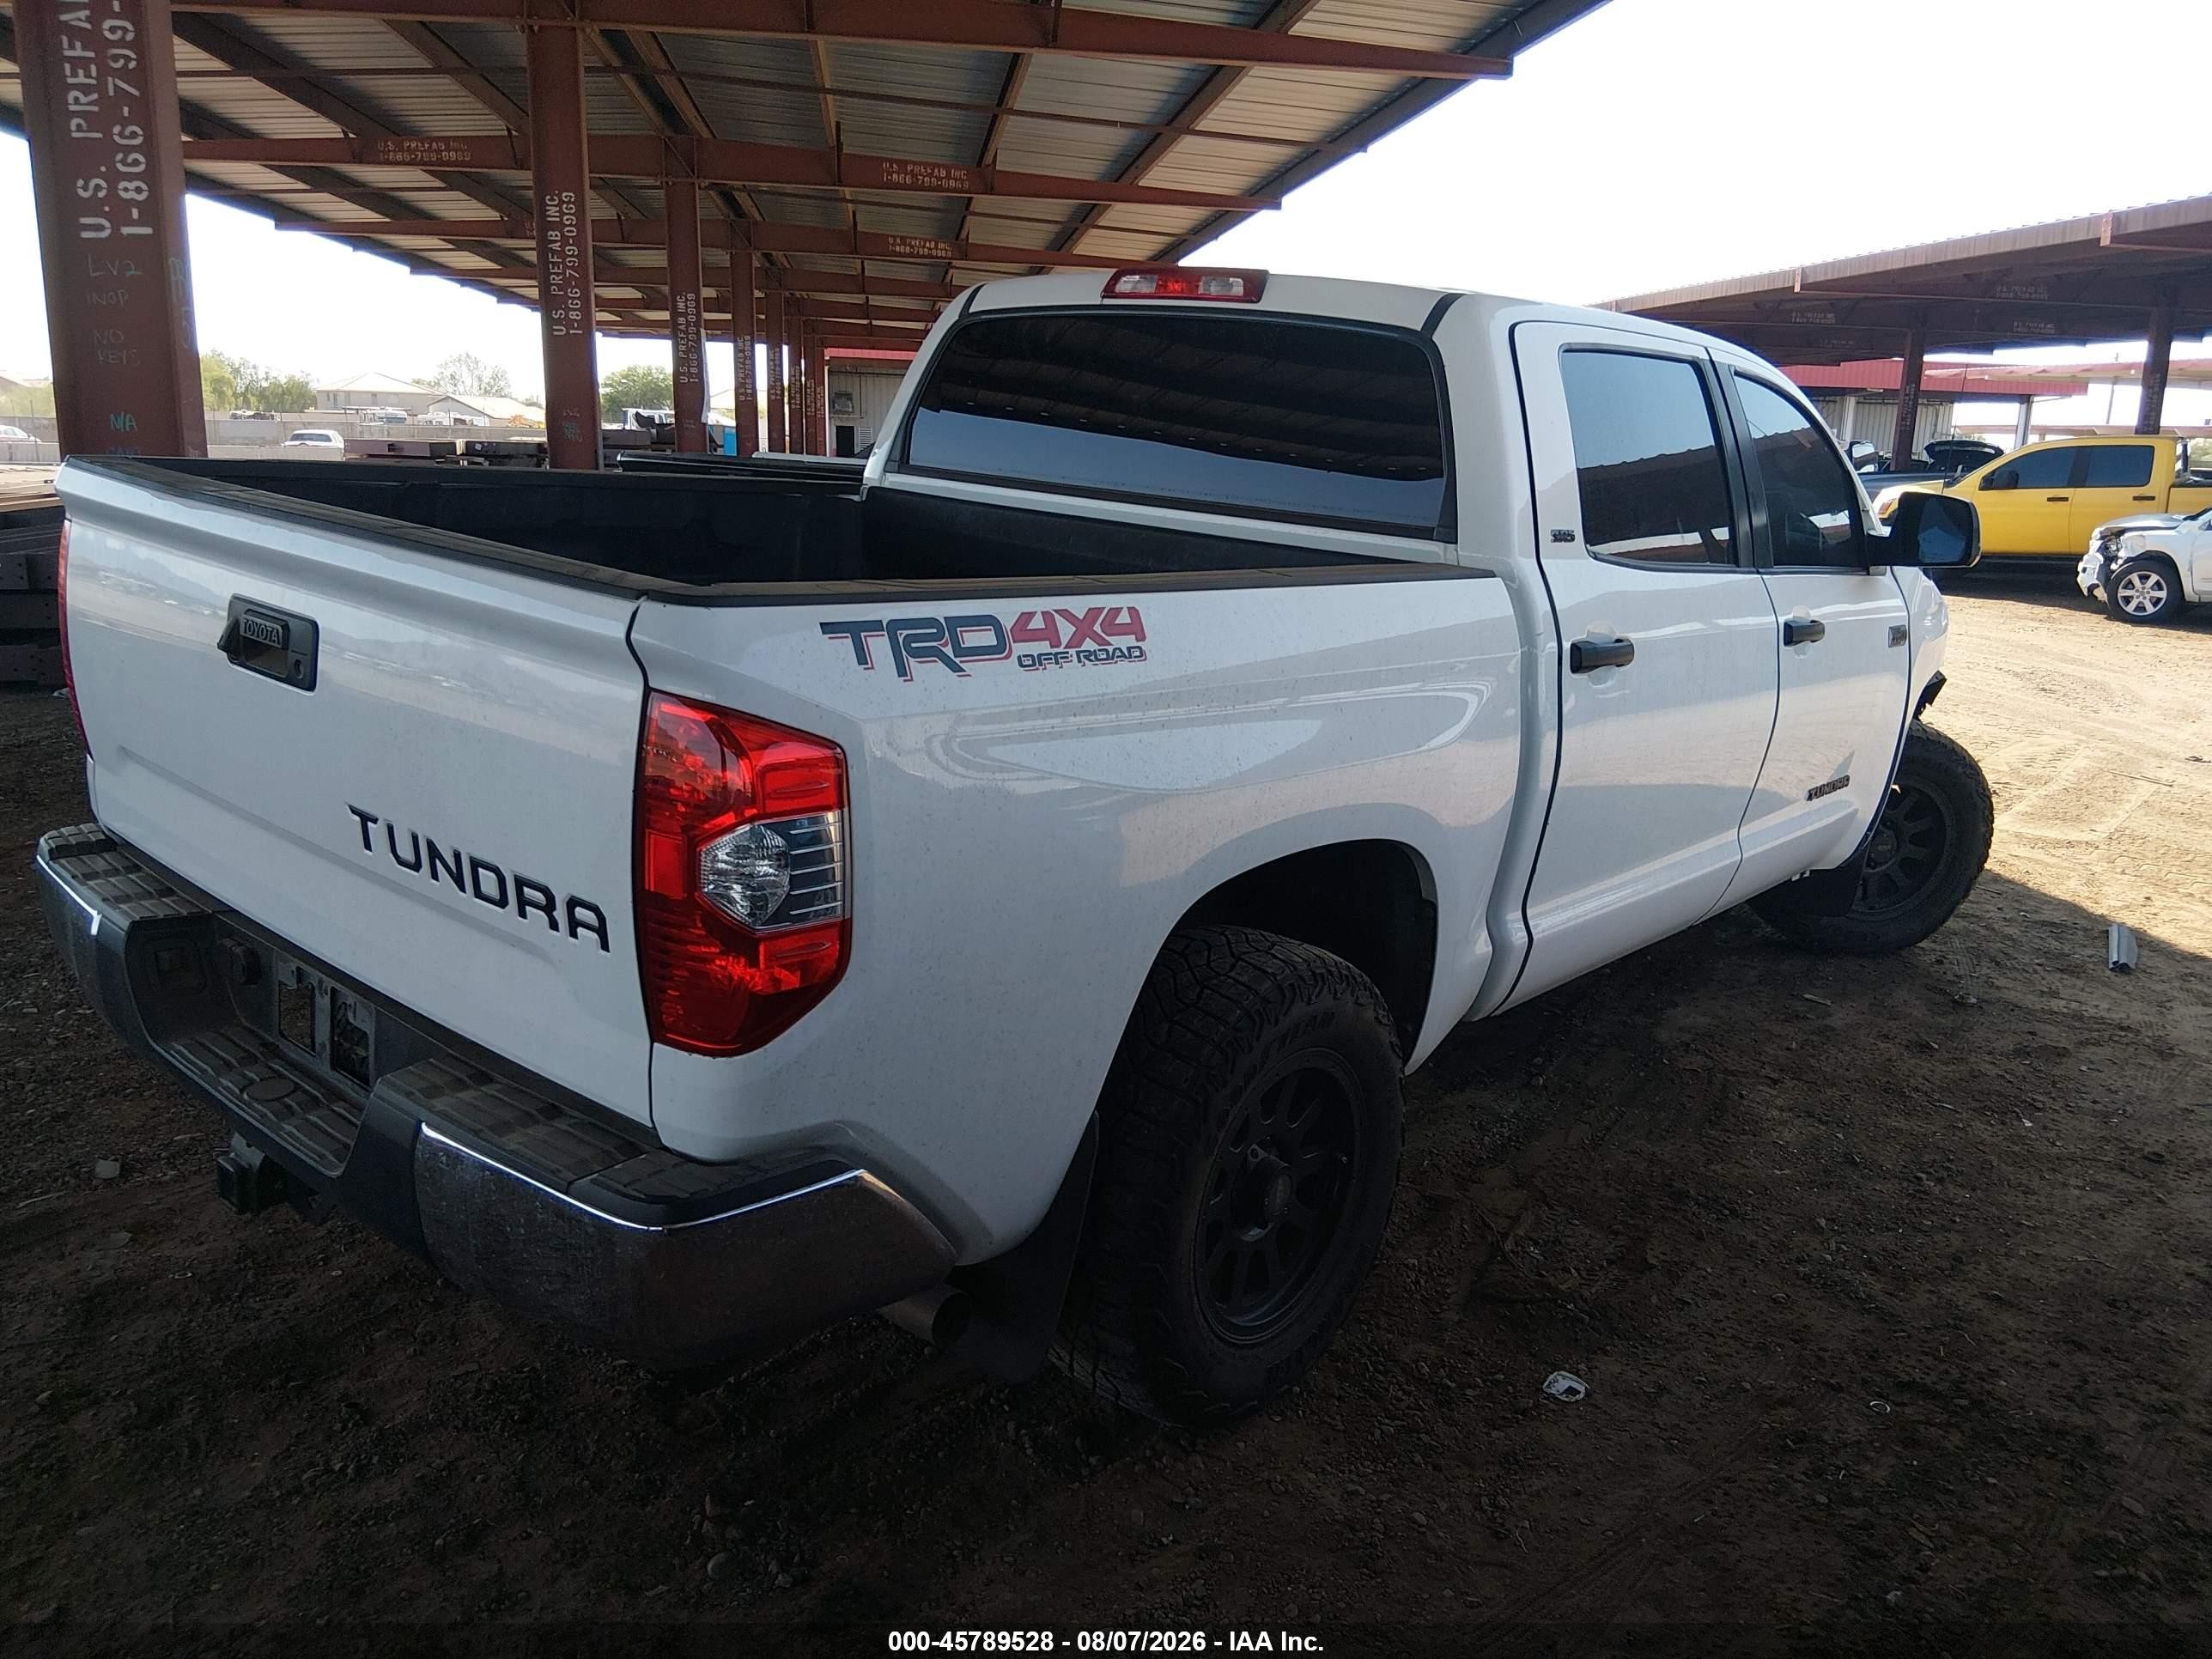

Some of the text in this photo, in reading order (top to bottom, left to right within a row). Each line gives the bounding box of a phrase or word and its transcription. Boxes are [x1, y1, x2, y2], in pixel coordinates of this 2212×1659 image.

[58, 0, 112, 240] U.S. PREFA
[545, 190, 567, 336] U.S. PREFAB INC.
[562, 191, 583, 335] 1-866-799-0969
[677, 292, 685, 313] INC.
[678, 317, 687, 358] PREFAB
[687, 293, 699, 382] 1-866-799-0969
[242, 618, 282, 647] TOYOTA
[819, 606, 1147, 683] TRD 4X4
[1017, 645, 1147, 672] OFF ROAD
[347, 802, 611, 953] TUNDRA
